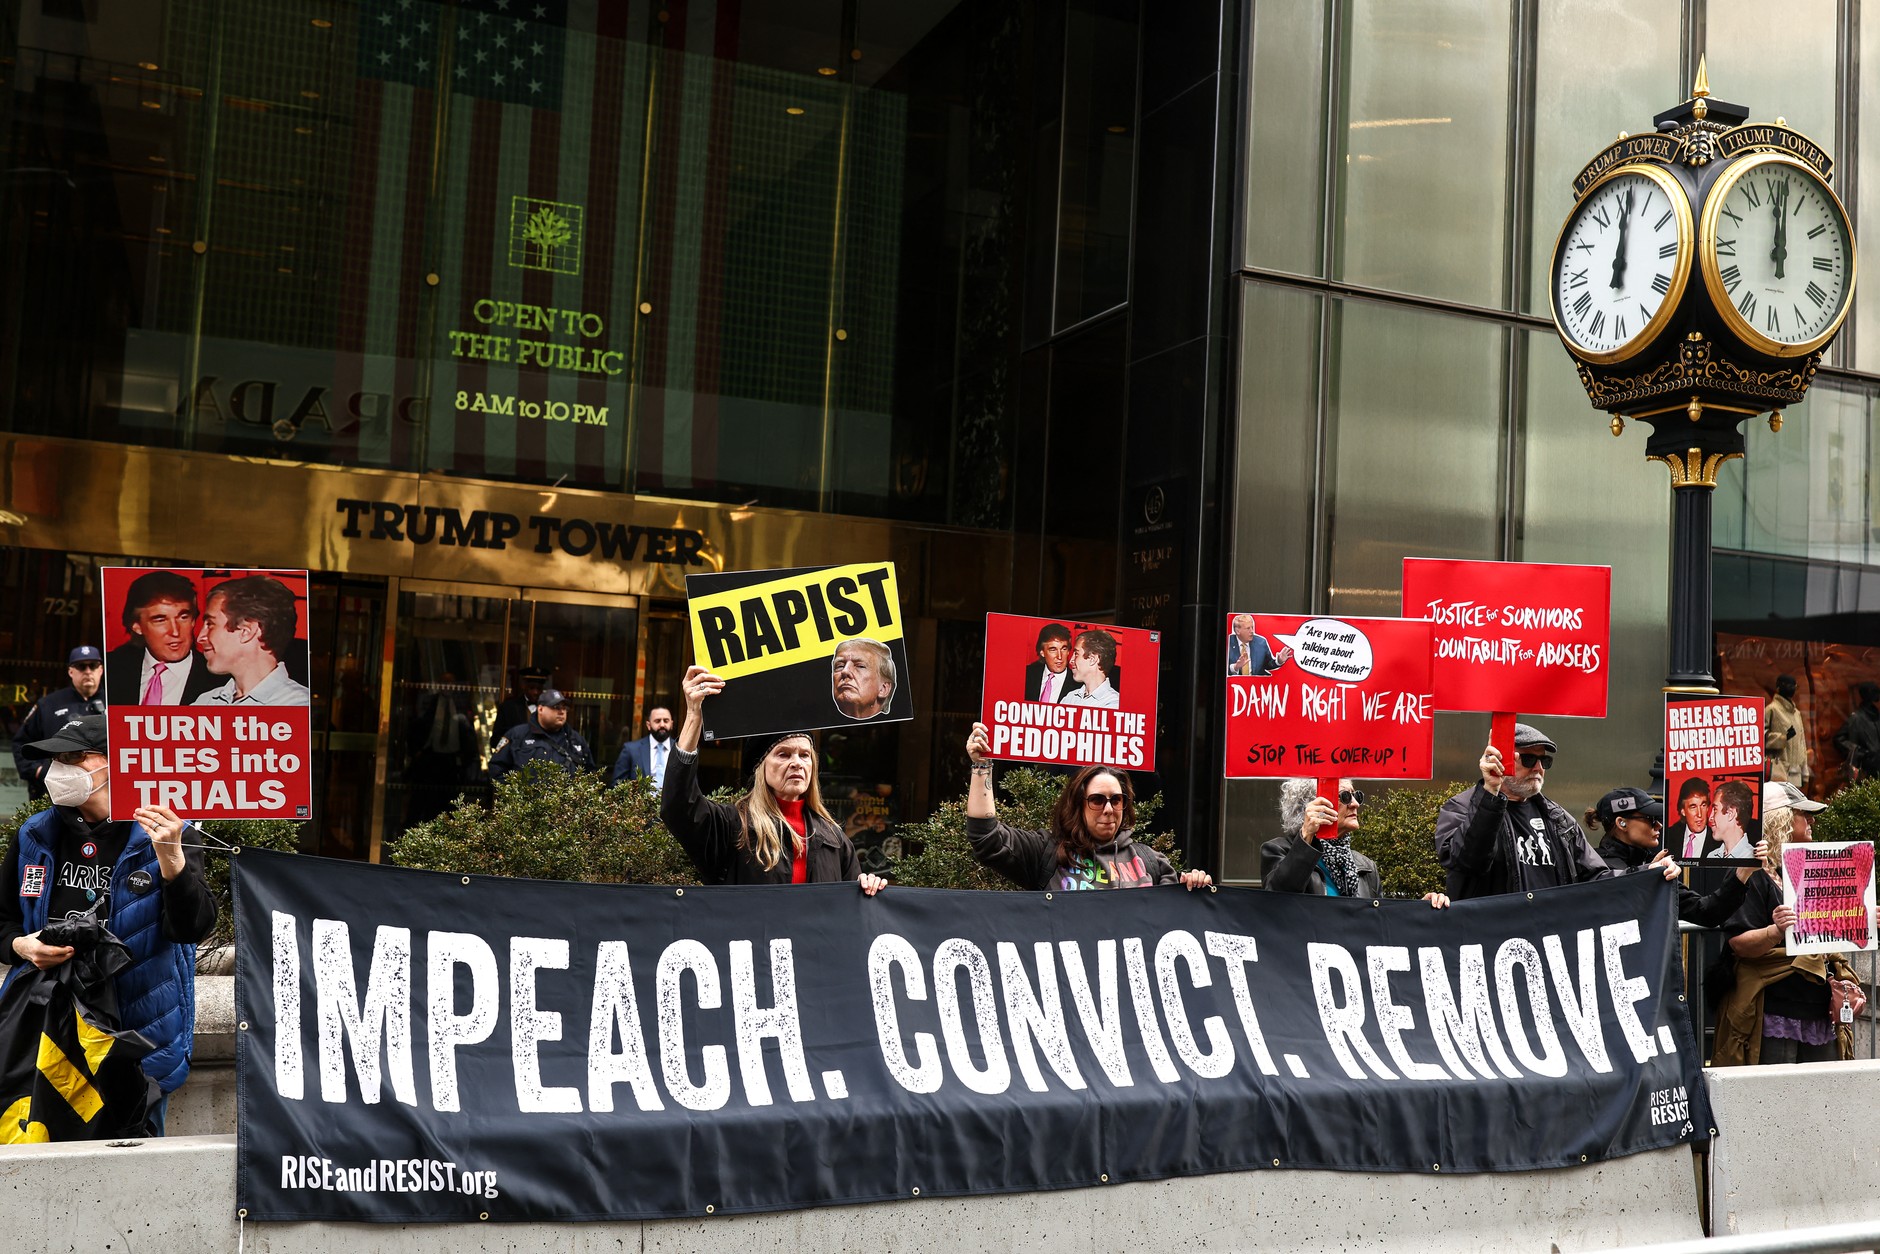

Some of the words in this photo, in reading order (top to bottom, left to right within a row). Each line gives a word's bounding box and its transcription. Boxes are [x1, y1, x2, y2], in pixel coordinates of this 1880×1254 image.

[1725, 129, 1774, 150] TRUMP
[1780, 131, 1824, 170] TOWER
[1579, 144, 1622, 187] TRUMP
[1627, 139, 1670, 157] TOWER
[474, 299, 558, 333] OPEN
[562, 309, 603, 338] TO
[449, 331, 511, 362] THE
[516, 338, 624, 376] PUBLIC
[518, 400, 541, 418] to
[337, 498, 521, 550] TRUMP
[529, 515, 703, 566] TOWER
[1133, 546, 1173, 565] TRUMP
[44, 598, 79, 617] 725
[1131, 594, 1170, 610] TRUMP
[697, 567, 893, 667] RAPIST
[1424, 598, 1487, 629] JUSTICE
[1486, 608, 1499, 622] for
[1500, 605, 1584, 631] SURVIVORS
[1323, 630, 1338, 641] you
[1339, 633, 1356, 644] still
[1301, 642, 1328, 656] talking
[1330, 647, 1354, 659] about
[1535, 641, 1601, 674] ABUSERS
[1300, 656, 1329, 671] Jeffrey
[1230, 683, 1290, 721] DAMN
[1301, 682, 1359, 723] RIGHT
[1361, 690, 1393, 723] WE
[1391, 691, 1434, 725] ARE
[124, 715, 222, 741] TURN
[232, 716, 293, 742] the
[994, 700, 1077, 729] CONVICT
[1079, 708, 1110, 732] ALL
[1114, 711, 1146, 735] THE
[1669, 705, 1731, 729] RELEASE
[1732, 705, 1757, 725] the
[992, 724, 1144, 767] PEDOPHILES
[1669, 725, 1759, 750] UNREDACTED
[119, 748, 220, 773] FILES
[231, 747, 300, 773] into
[1247, 743, 1287, 766] STOP
[1294, 743, 1325, 765] THE
[1330, 746, 1394, 767] COVER-UP
[1669, 748, 1725, 771] EPSTEIN
[1727, 746, 1762, 767] FILES
[133, 779, 287, 810] TRIALS
[856, 806, 889, 816] OPEN
[1805, 849, 1853, 860] REBELLION
[34, 868, 43, 880] ICE
[1804, 867, 1856, 878] RESISTANCE
[32, 880, 41, 893] OUT
[1804, 886, 1857, 897] REVOLUTION
[1800, 908, 1830, 919] whatever
[1831, 909, 1844, 921] you
[1845, 906, 1858, 917] call
[1858, 906, 1864, 916] it
[1792, 931, 1814, 945] WE.
[1816, 930, 1840, 943] ARE.
[1840, 927, 1873, 942] HERE.
[271, 909, 849, 1113] IMPEACH.
[867, 929, 1310, 1095] CONVICT.
[1306, 918, 1677, 1081] REMOVE.
[1651, 1089, 1670, 1106] RISE
[1651, 1101, 1689, 1125] RESIST
[281, 1155, 498, 1199] RISEandRESIST.org
